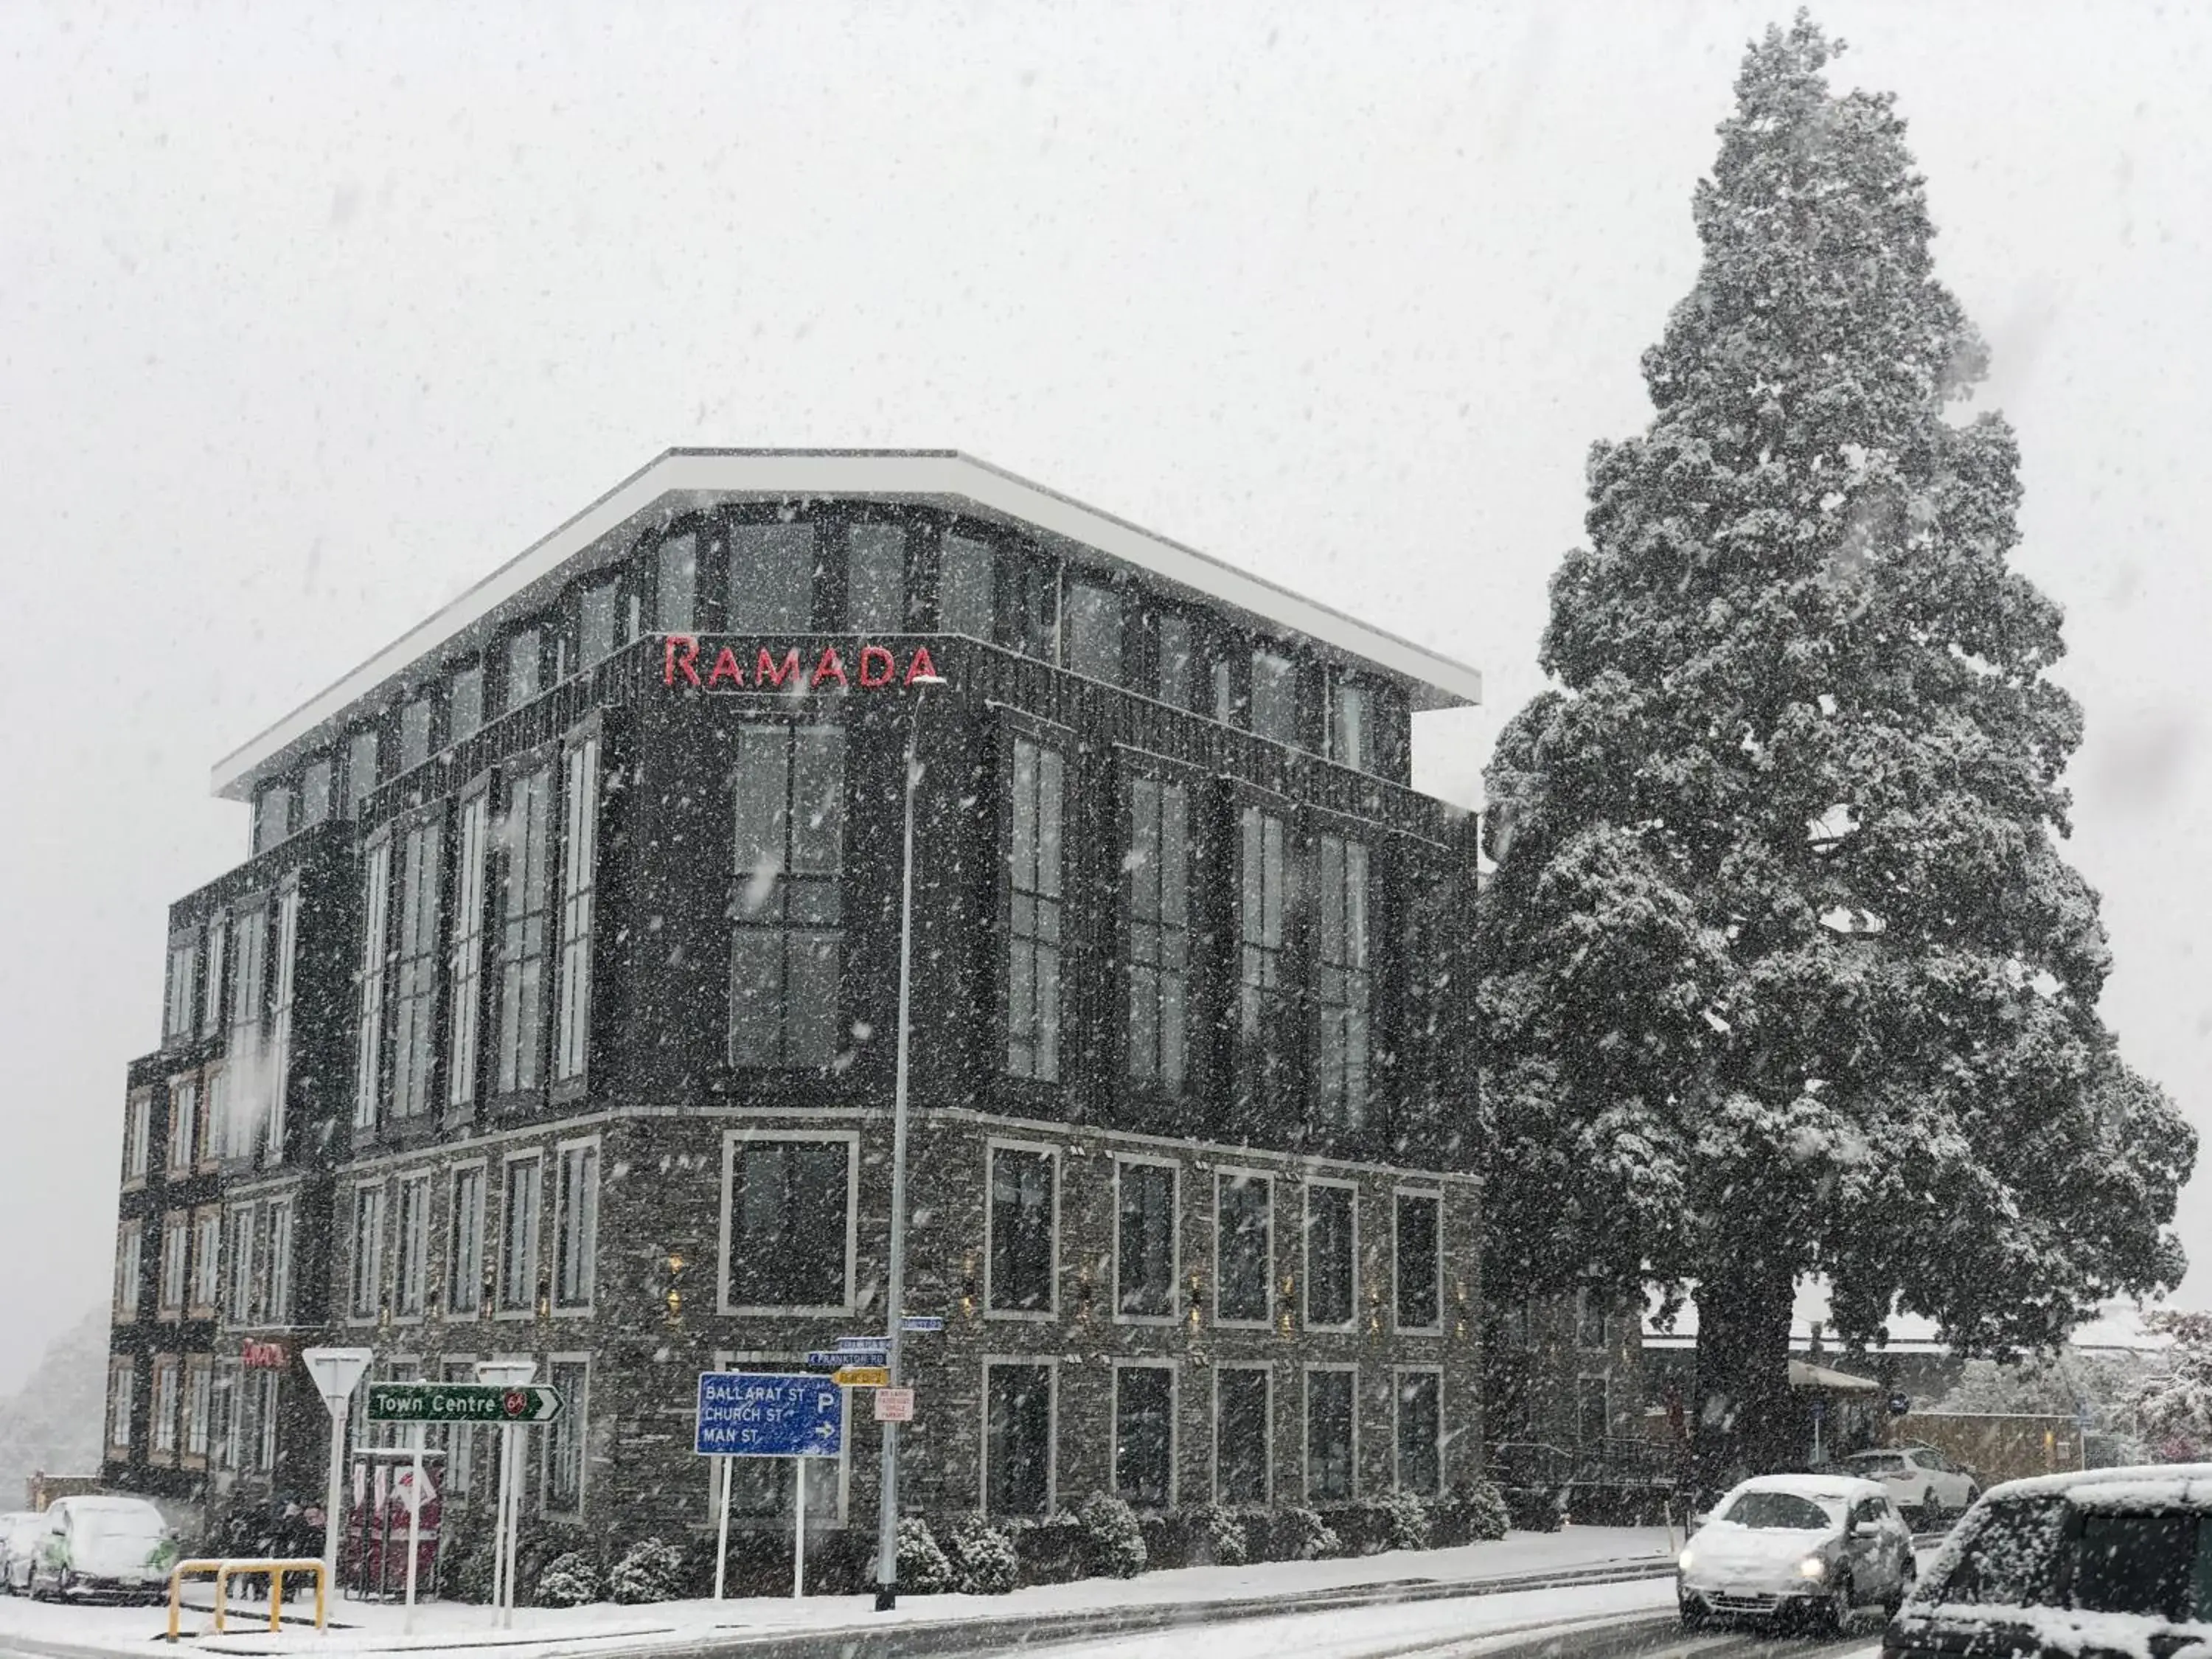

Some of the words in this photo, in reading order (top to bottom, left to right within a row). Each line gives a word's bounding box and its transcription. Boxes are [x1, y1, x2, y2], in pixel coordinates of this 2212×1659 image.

[664, 634, 939, 687] RAMADA
[818, 1354, 867, 1364] FRANKTON
[871, 1354, 884, 1364] RD
[705, 1386, 782, 1400] BALLARAT
[788, 1388, 805, 1400] ST
[376, 1394, 423, 1412] Town
[431, 1394, 496, 1412] Centre
[818, 1393, 834, 1413] P
[705, 1407, 760, 1422] CHURCH
[765, 1408, 782, 1422] ST
[703, 1428, 735, 1442] MAN
[741, 1429, 758, 1442] ST
